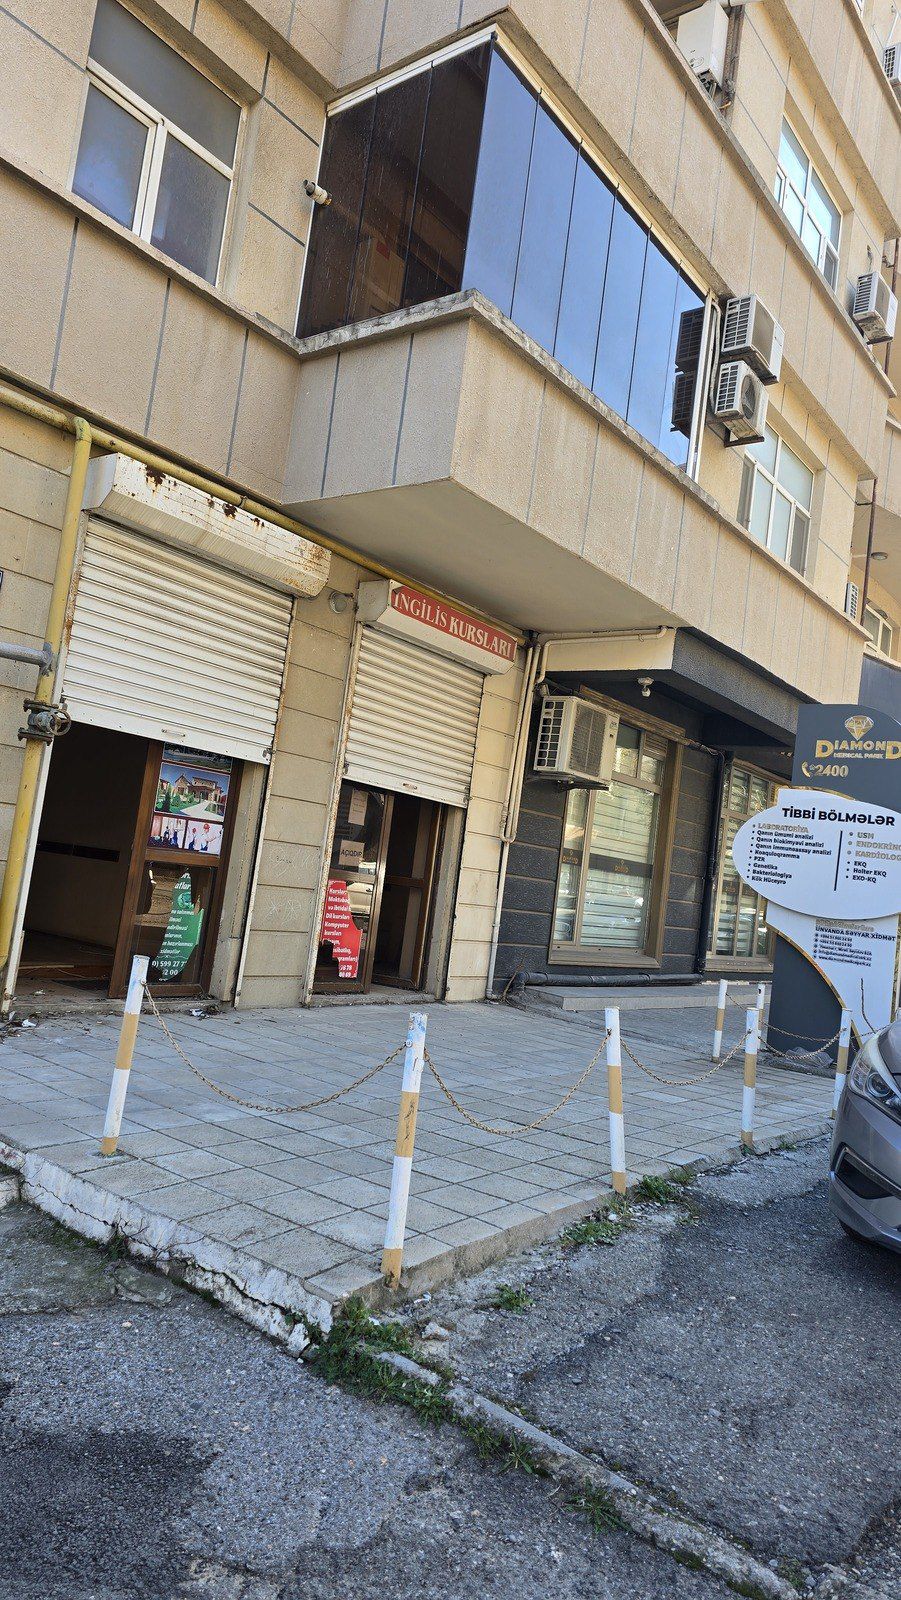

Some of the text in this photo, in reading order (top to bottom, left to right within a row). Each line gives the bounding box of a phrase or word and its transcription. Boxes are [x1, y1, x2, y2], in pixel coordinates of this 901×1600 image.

[449, 616, 511, 657] KURSLARI
[815, 740, 901, 760] DIAMOND
[815, 764, 849, 777] 2400
[782, 806, 895, 826] TİBBİ BÖLMƏLƏR
